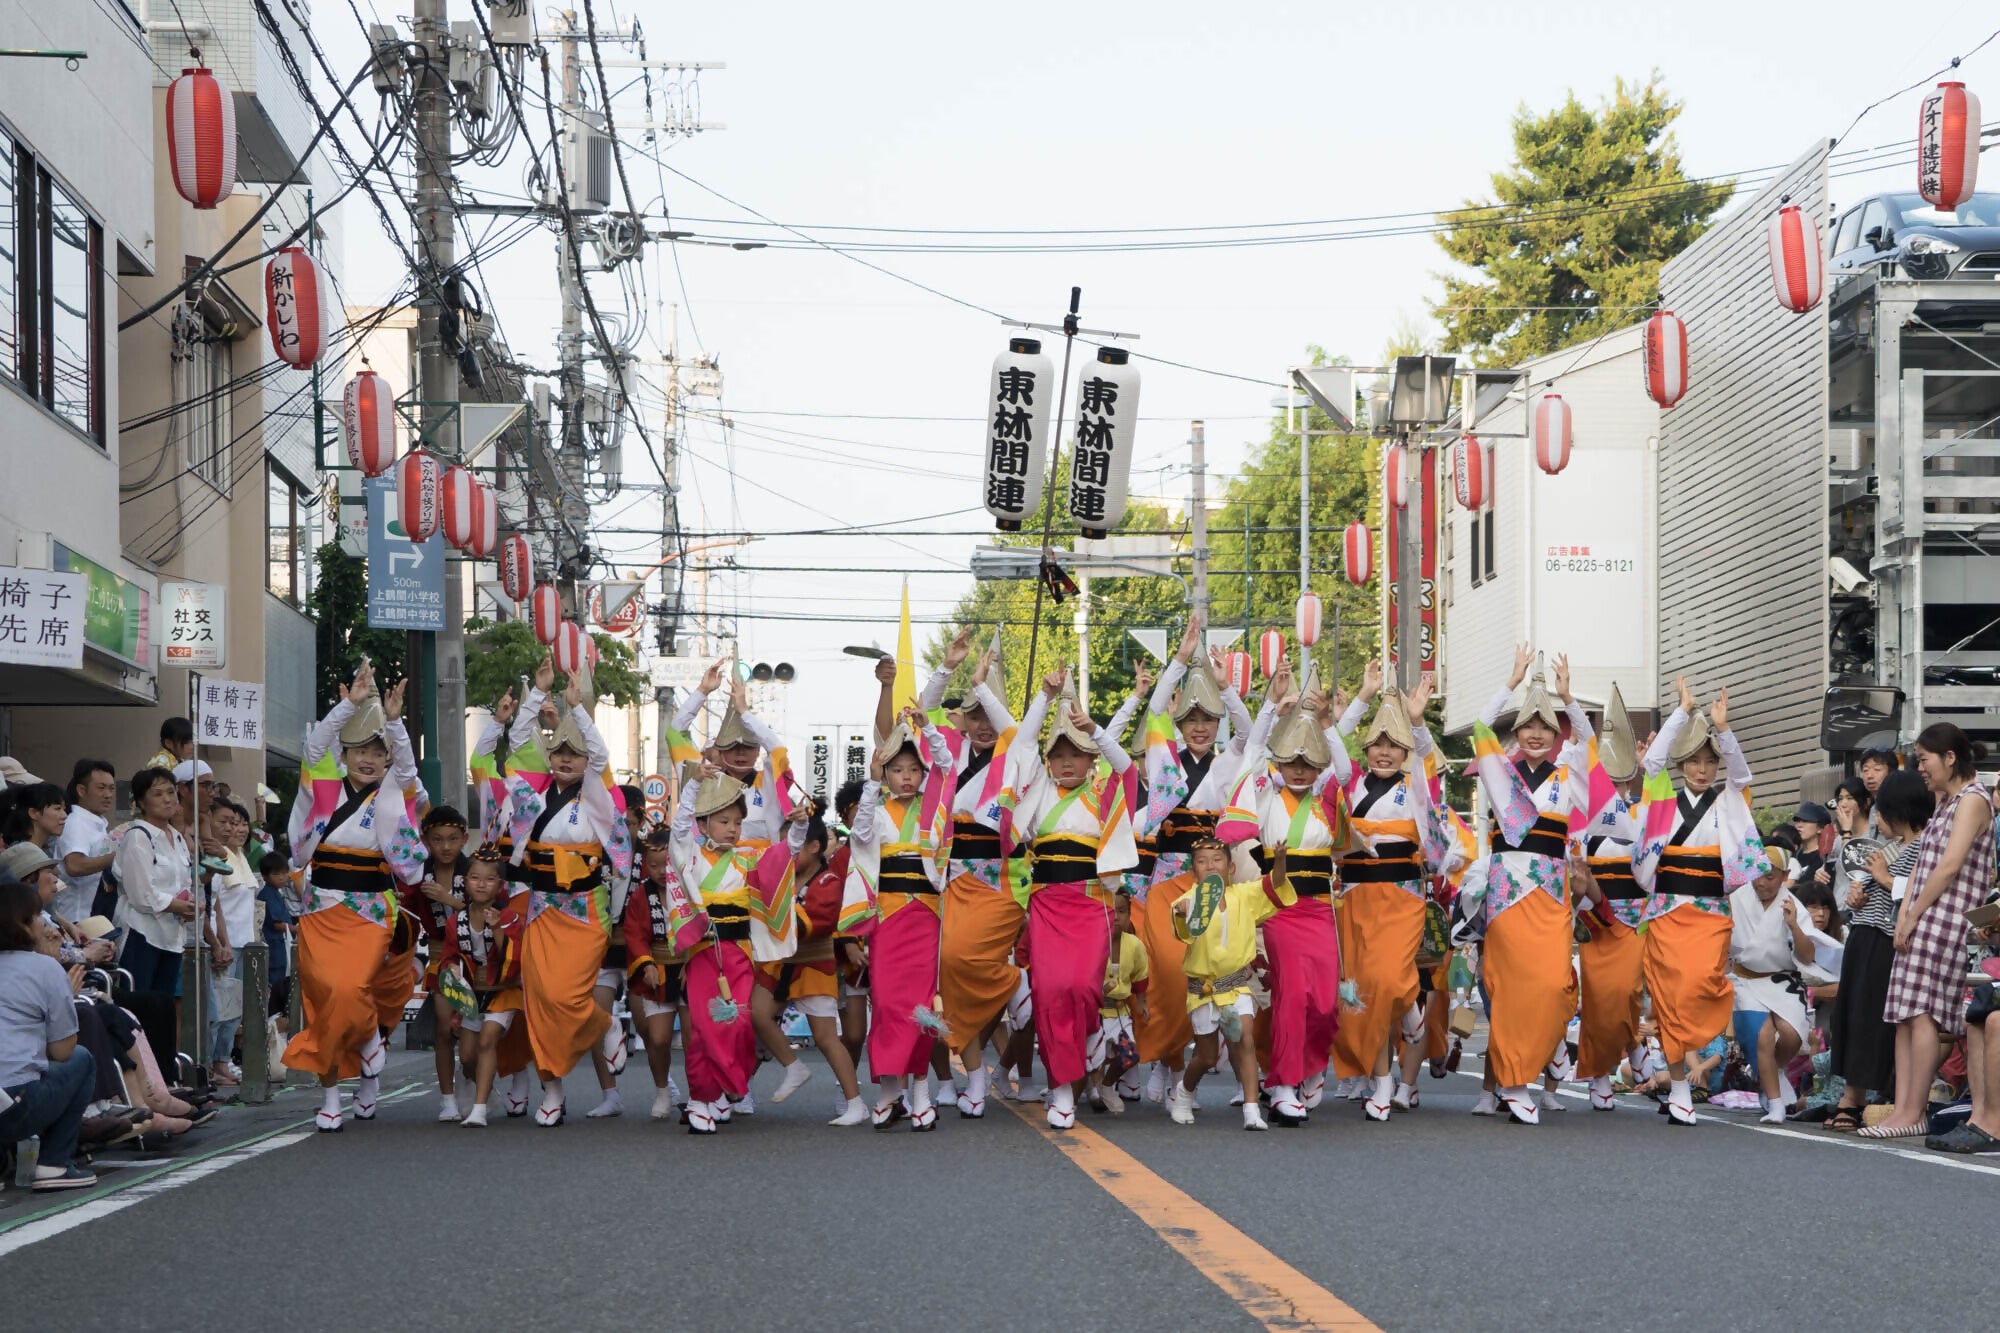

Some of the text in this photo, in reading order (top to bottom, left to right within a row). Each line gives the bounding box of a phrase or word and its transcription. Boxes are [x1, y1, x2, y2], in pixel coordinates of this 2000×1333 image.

[271, 266, 299, 348] 新かしわ
[987, 366, 1036, 513] 東林間連
[1070, 376, 1119, 521] 東林間連
[1545, 559, 1634, 572] 06-6225-8121
[393, 577, 421, 588] 500m
[374, 588, 440, 604] 上鶴間小学校
[174, 608, 210, 624] 社交
[374, 607, 440, 622] 上鶴間中学校
[171, 626, 214, 642] ダンス
[177, 648, 191, 657] 2F
[205, 684, 258, 710] 車椅子
[203, 714, 257, 741] 優先席
[647, 782, 664, 796] 40
